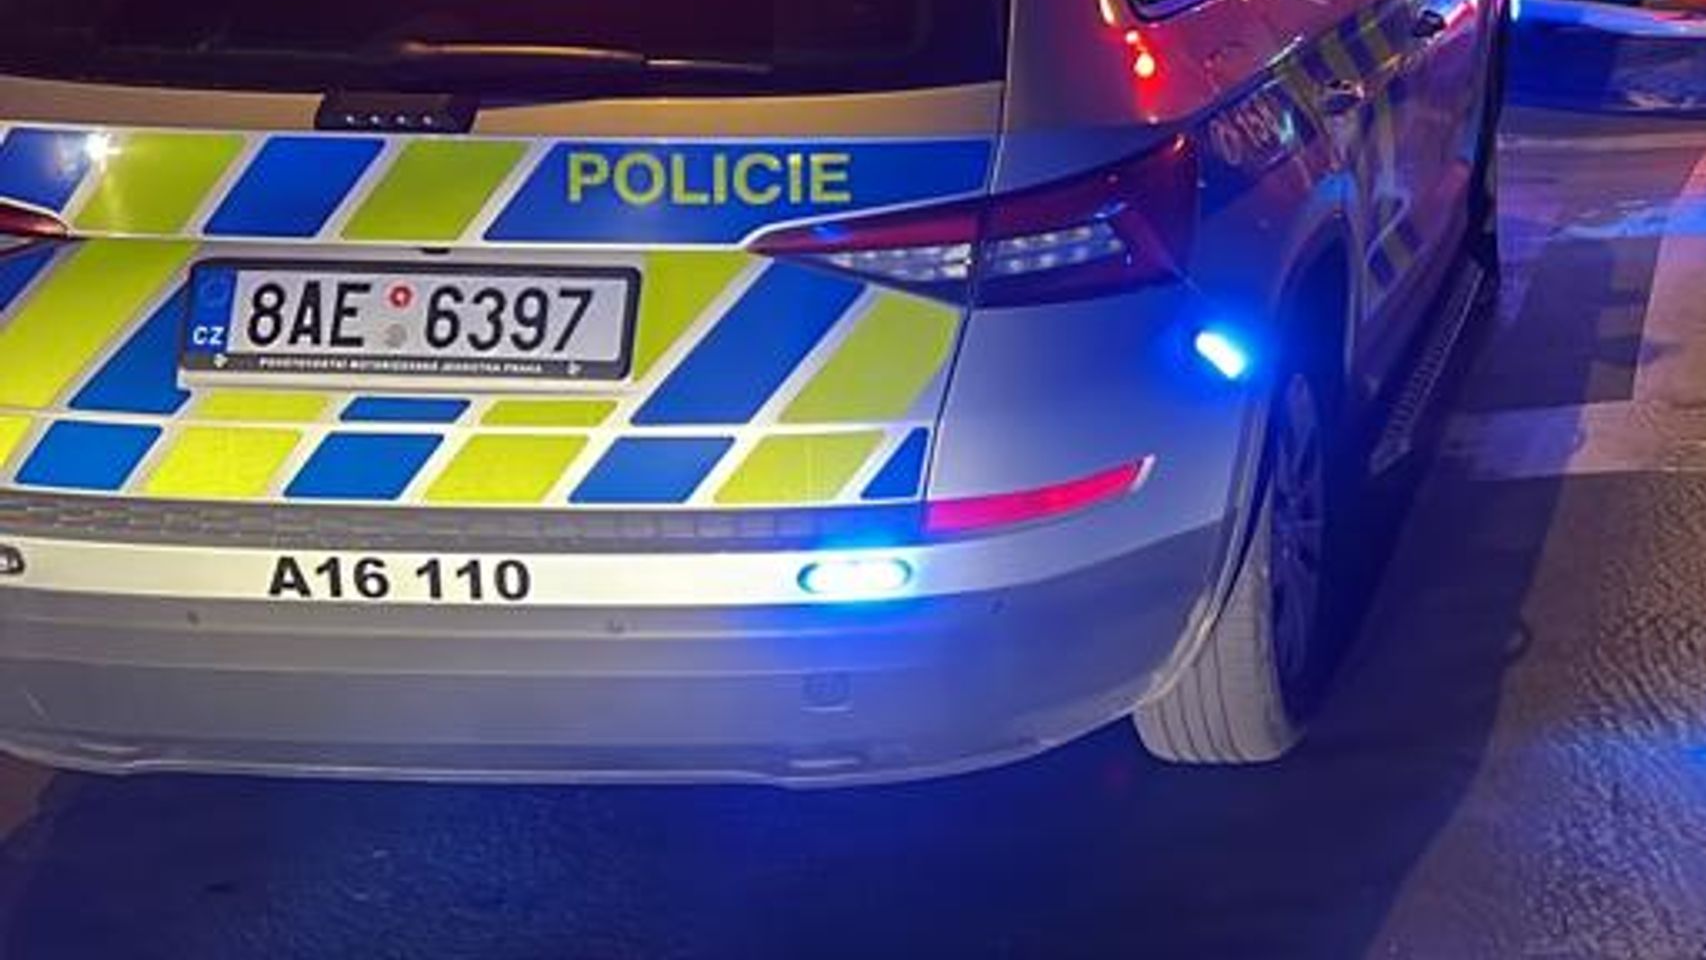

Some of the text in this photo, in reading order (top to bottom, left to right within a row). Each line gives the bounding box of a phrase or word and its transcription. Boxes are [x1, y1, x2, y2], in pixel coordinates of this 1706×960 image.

[567, 152, 851, 205] POLICIE
[193, 326, 223, 344] CZ
[247, 281, 595, 353] 8AE 6397
[268, 556, 531, 600] A16 110
